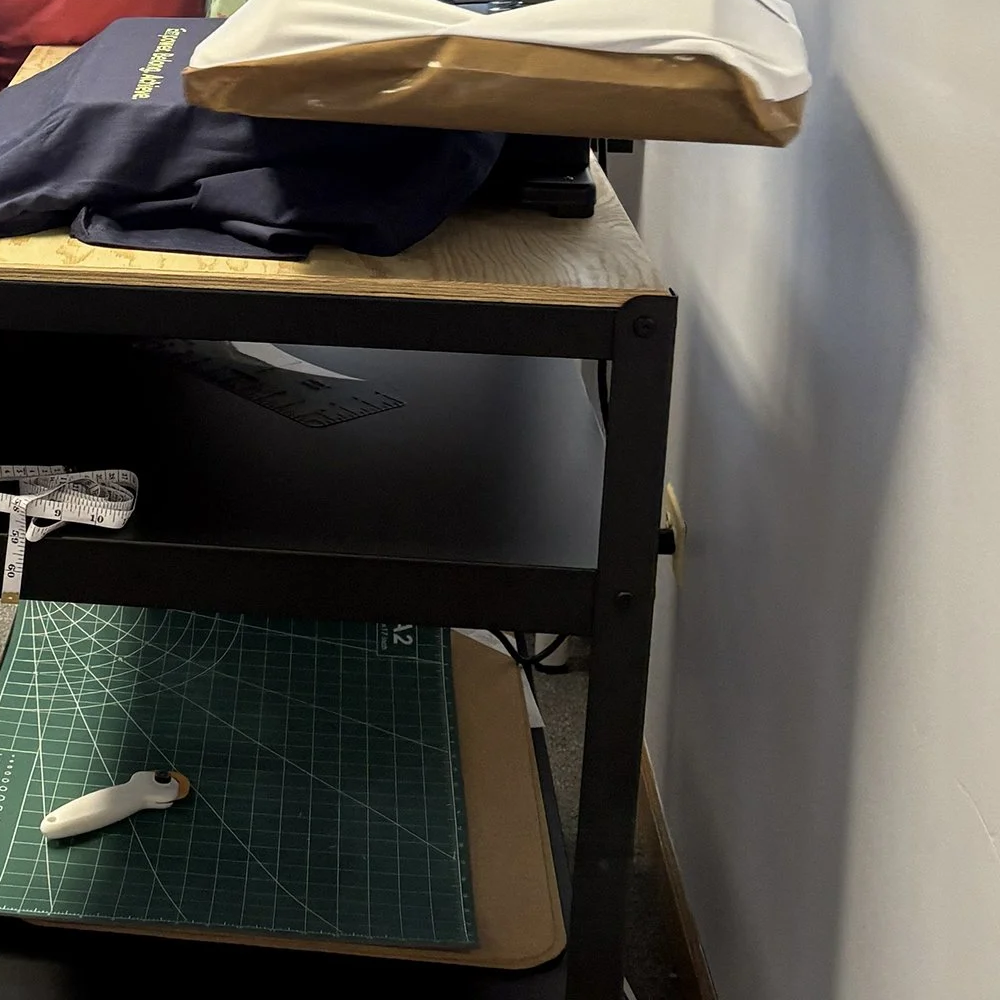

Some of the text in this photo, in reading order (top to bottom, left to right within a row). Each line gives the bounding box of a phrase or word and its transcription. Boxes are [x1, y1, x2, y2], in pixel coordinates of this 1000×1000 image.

[90, 514, 104, 524] 10
[11, 529, 20, 544] 59
[7, 563, 16, 578] 60
